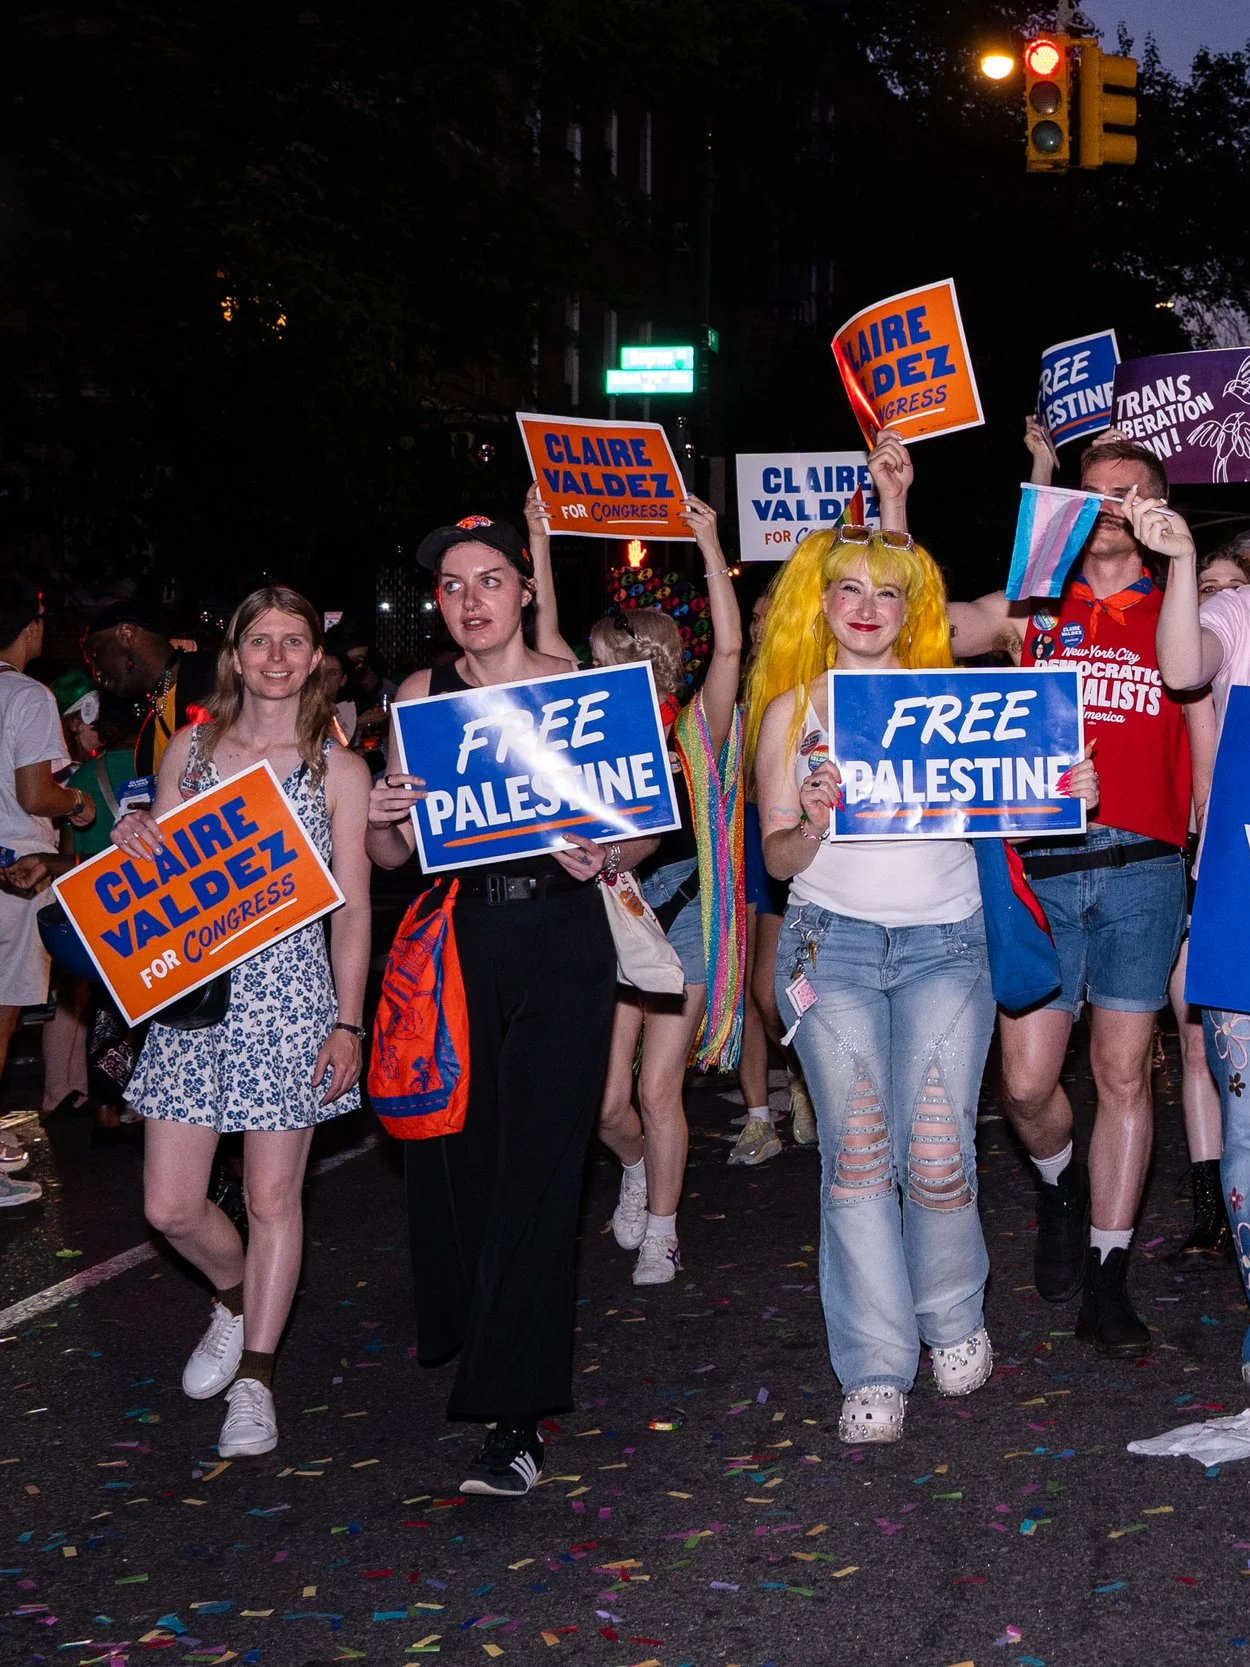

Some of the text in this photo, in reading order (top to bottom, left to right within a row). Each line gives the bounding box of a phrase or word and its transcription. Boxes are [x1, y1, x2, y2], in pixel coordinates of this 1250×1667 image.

[845, 305, 931, 371] LAIRE
[860, 344, 956, 402] LDEZ
[1038, 350, 1091, 402] REE
[877, 384, 948, 424] NGRESS
[1116, 374, 1191, 420] TRANS
[1117, 391, 1214, 439] IBERATION
[544, 433, 652, 467] CLAIRE
[542, 467, 674, 498] VALDEZ
[762, 465, 872, 494] CLAIRE
[561, 502, 668, 522] FOR CONGRESS
[751, 496, 880, 521] VALDZ
[764, 530, 791, 545] FOR
[1061, 645, 1140, 665] New York City
[881, 689, 1038, 749] FREE
[1082, 678, 1162, 716] ALISTS
[1083, 707, 1126, 724] merica
[456, 690, 610, 775] FREE
[425, 752, 661, 836] PALESTINE
[845, 756, 1073, 805] PALESTINE
[94, 796, 259, 915] CLAIRE
[100, 829, 299, 959] VALDEZ
[139, 872, 296, 989] FOR CONGRESS
